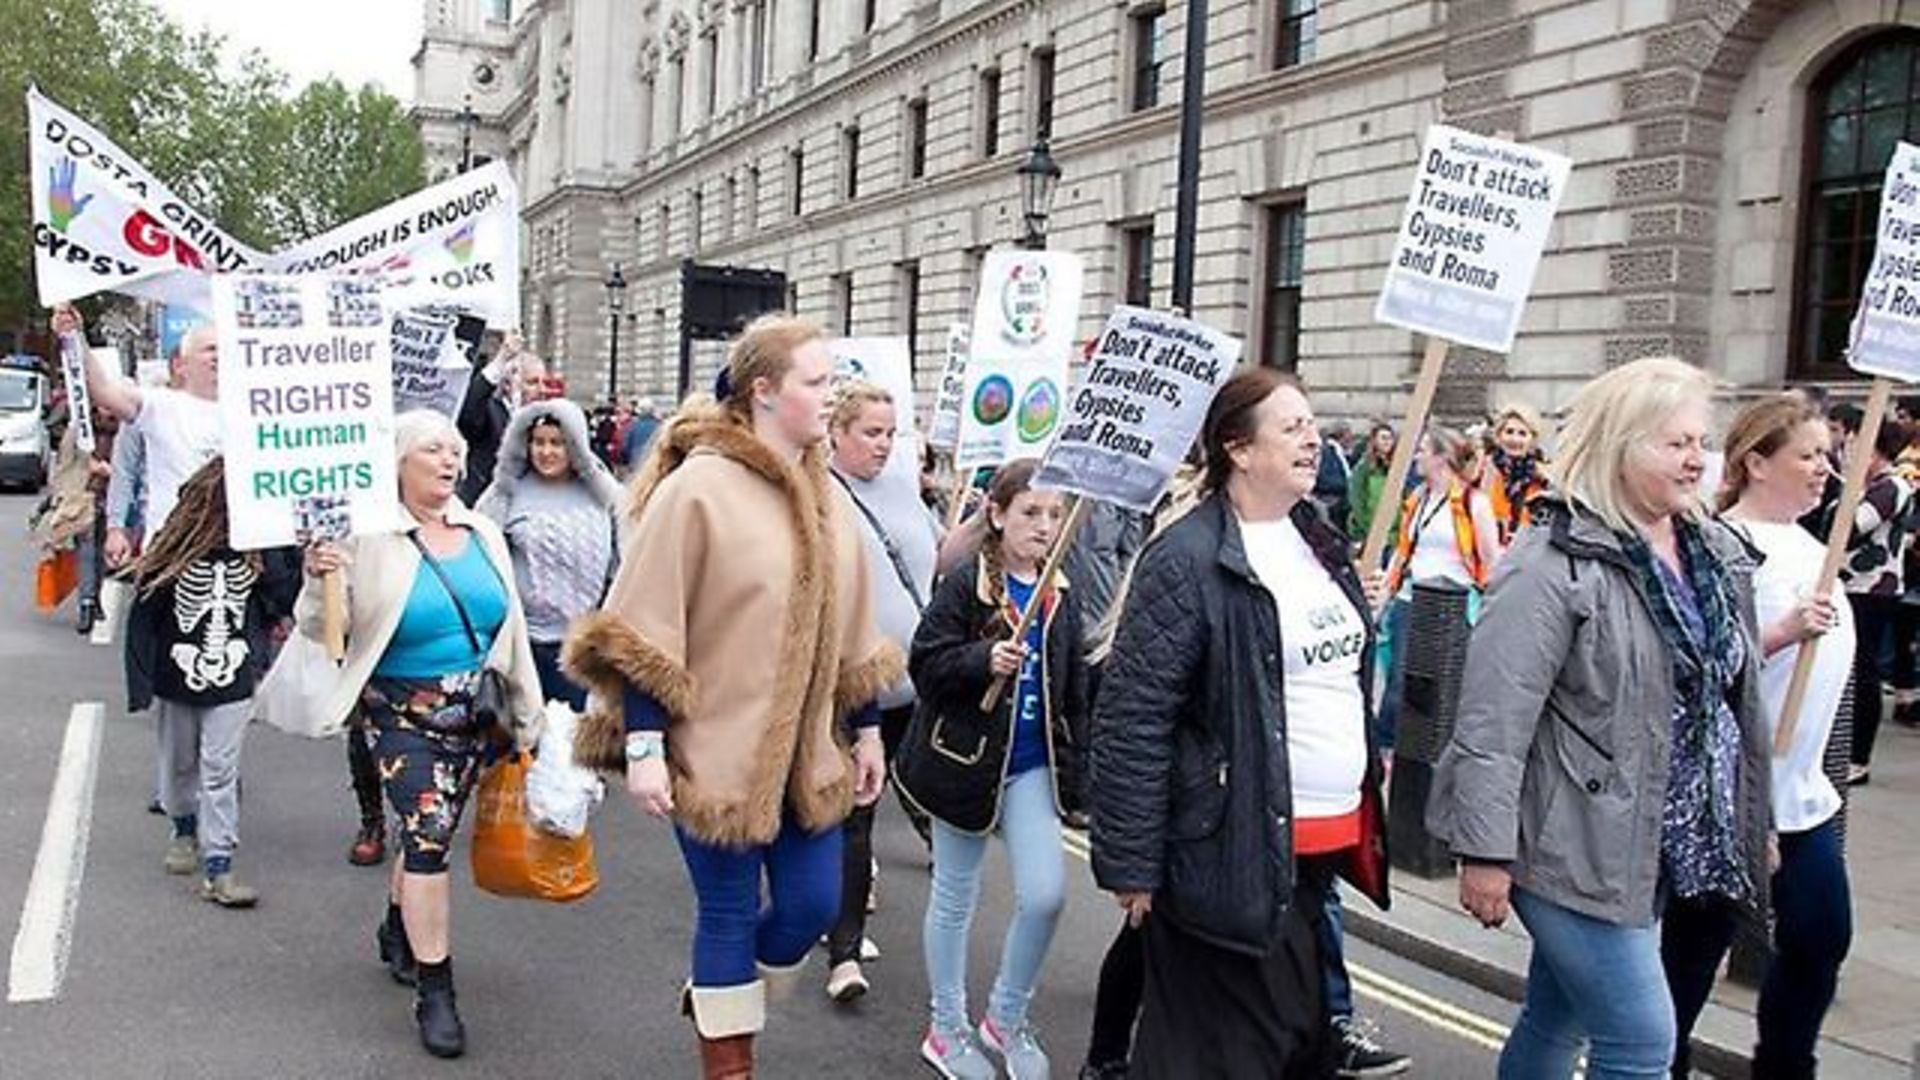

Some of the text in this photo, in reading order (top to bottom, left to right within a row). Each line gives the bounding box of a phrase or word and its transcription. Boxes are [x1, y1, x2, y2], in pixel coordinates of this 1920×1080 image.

[46, 118, 148, 198] DOSTA
[161, 203, 264, 272] GRINT
[1427, 148, 1551, 201] Don't attack
[392, 220, 411, 243] IS
[418, 183, 498, 234] ENOUGH
[1418, 178, 1521, 233] Travellers,
[34, 222, 139, 276] GYPSY
[1408, 210, 1485, 253] Gypsies
[1399, 246, 1500, 291] and Roma
[238, 336, 376, 368] Traveller
[1101, 328, 1221, 385] Don't attack
[249, 382, 372, 416] RIGHTS
[1074, 387, 1145, 424] Gypsies
[1087, 358, 1182, 410] Travellers,
[257, 421, 366, 450] Human
[1061, 420, 1154, 460] and Roma
[253, 462, 373, 499] RIGHTS
[1302, 632, 1361, 666] VOICE
